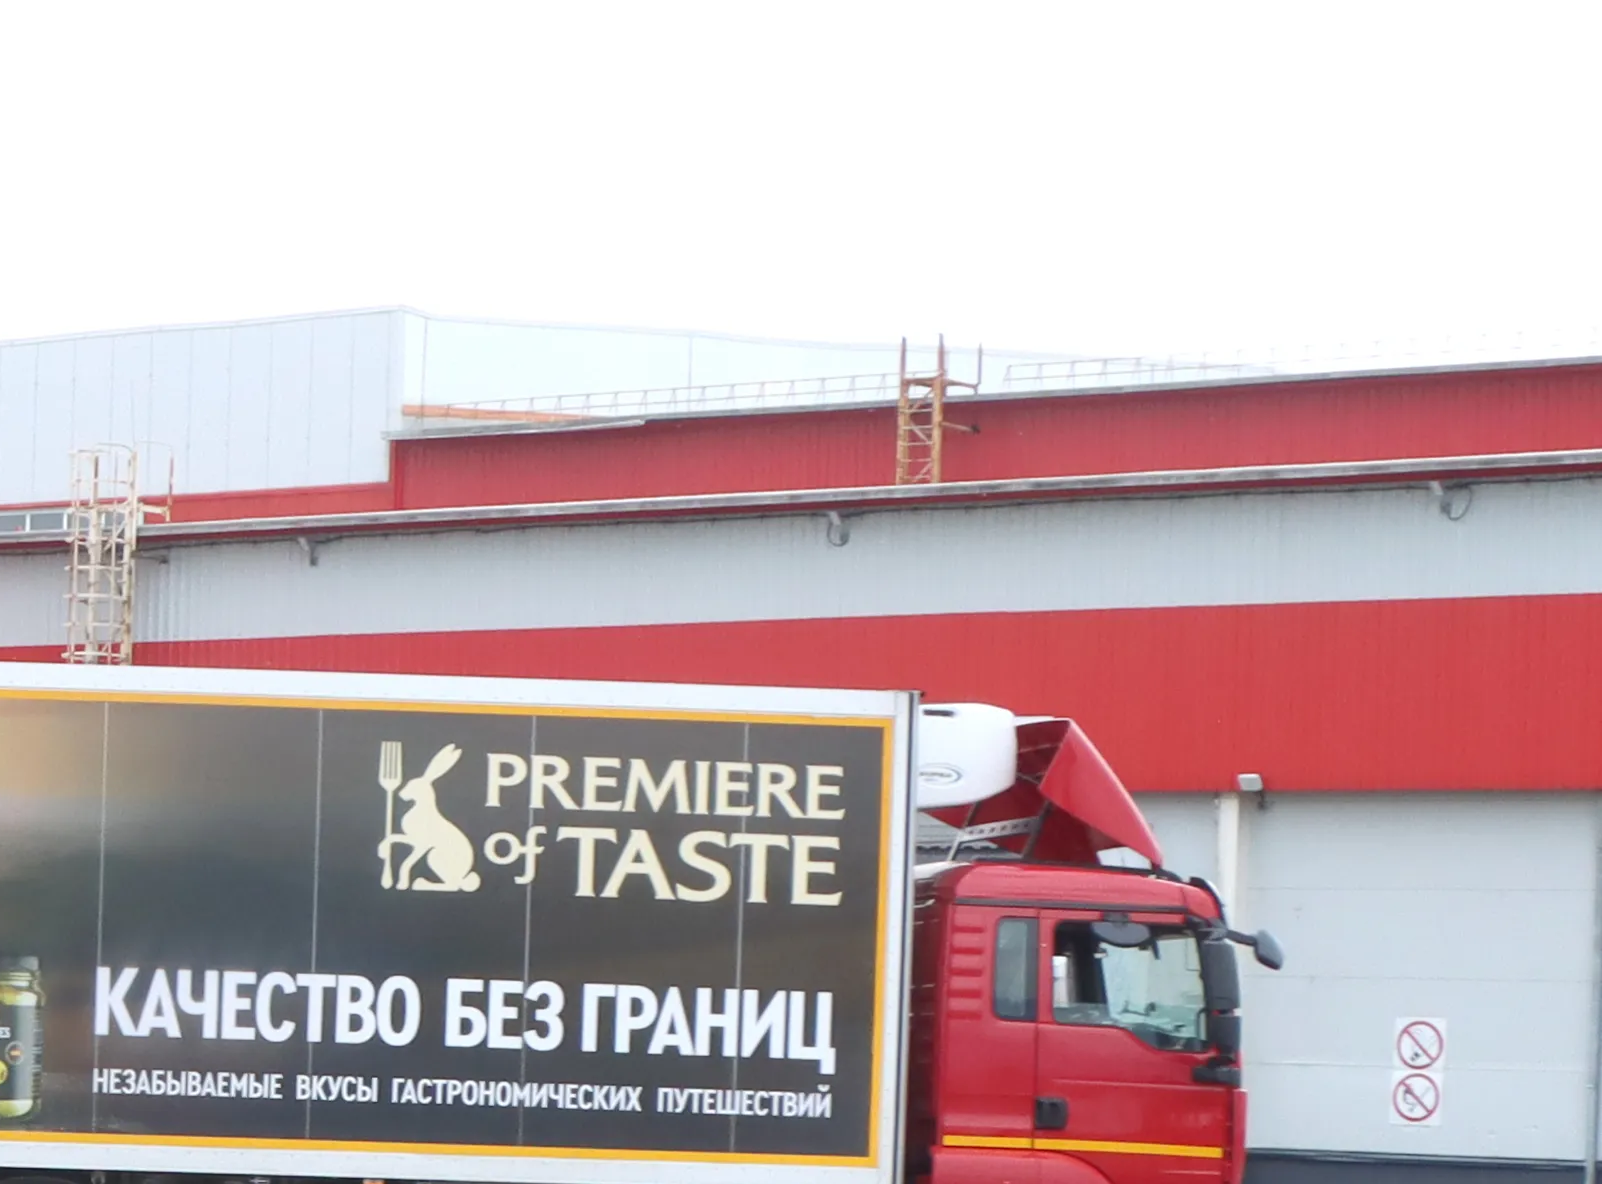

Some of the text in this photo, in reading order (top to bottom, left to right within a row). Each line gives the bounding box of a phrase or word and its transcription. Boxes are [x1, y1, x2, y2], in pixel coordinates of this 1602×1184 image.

[485, 752, 846, 820] PREMIERE
[483, 825, 842, 906] of TASTE
[94, 966, 837, 1075] КАЧЕСТВО БЕЗ ГРАНИЦ
[92, 1067, 832, 1119] НЕЗАБЫВАЕМЫЕ ВКУСЫ ГАСТРОНОМИЧЕСКИХ ПУТЕШЕСТВИЙ
